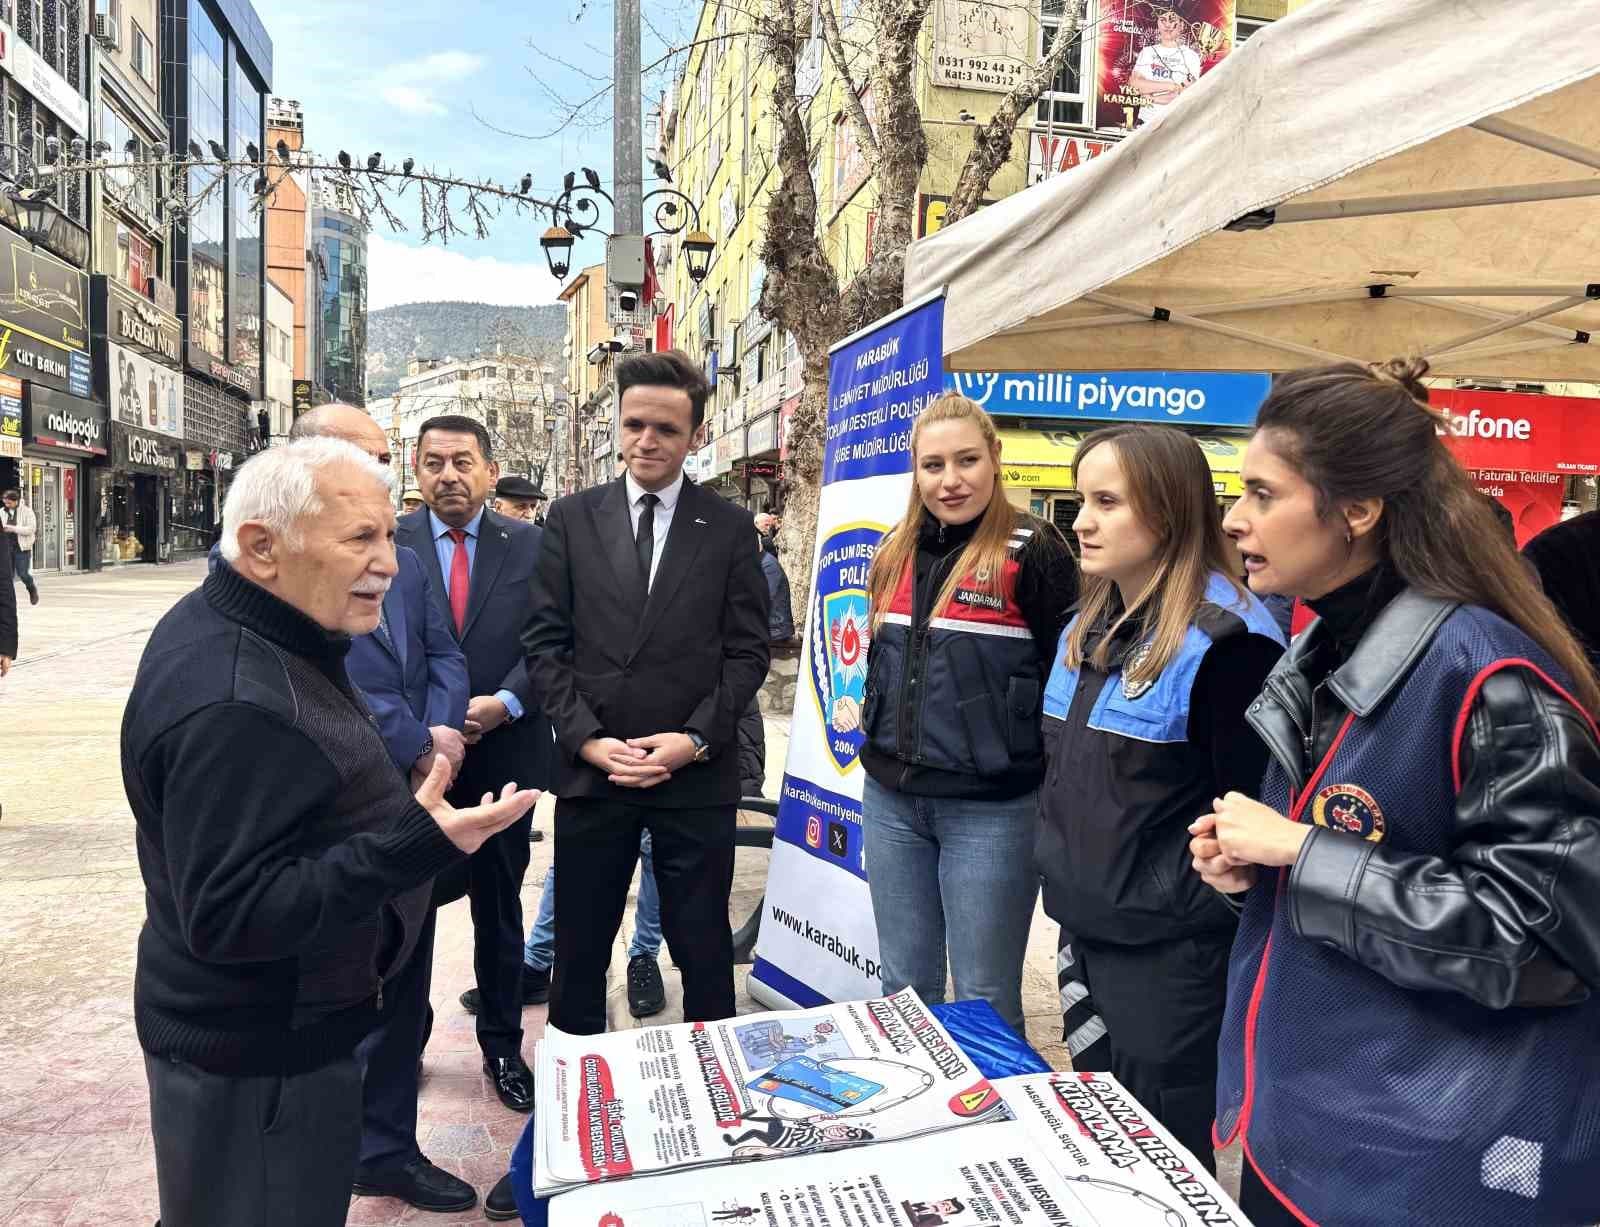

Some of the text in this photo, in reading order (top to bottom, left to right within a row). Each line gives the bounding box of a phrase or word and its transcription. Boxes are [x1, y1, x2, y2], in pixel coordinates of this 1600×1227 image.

[938, 56, 1021, 75] 0531 992 44 34
[945, 69, 972, 80] Kat:3
[37, 355, 67, 379] BAKIMI
[856, 336, 900, 371] KARABÜK
[1003, 373, 1206, 416] milli piyango
[820, 544, 856, 572] TOPLUM
[958, 591, 1002, 609] JANDARMA
[834, 740, 855, 756] 2006
[1022, 1084, 1044, 1111] MASUM
[1085, 1080, 1150, 1138] BANKA
[1053, 1080, 1141, 1168] KİRALAMA
[1007, 1157, 1039, 1184] BANKA
[1026, 1184, 1067, 1221] HESABINI
